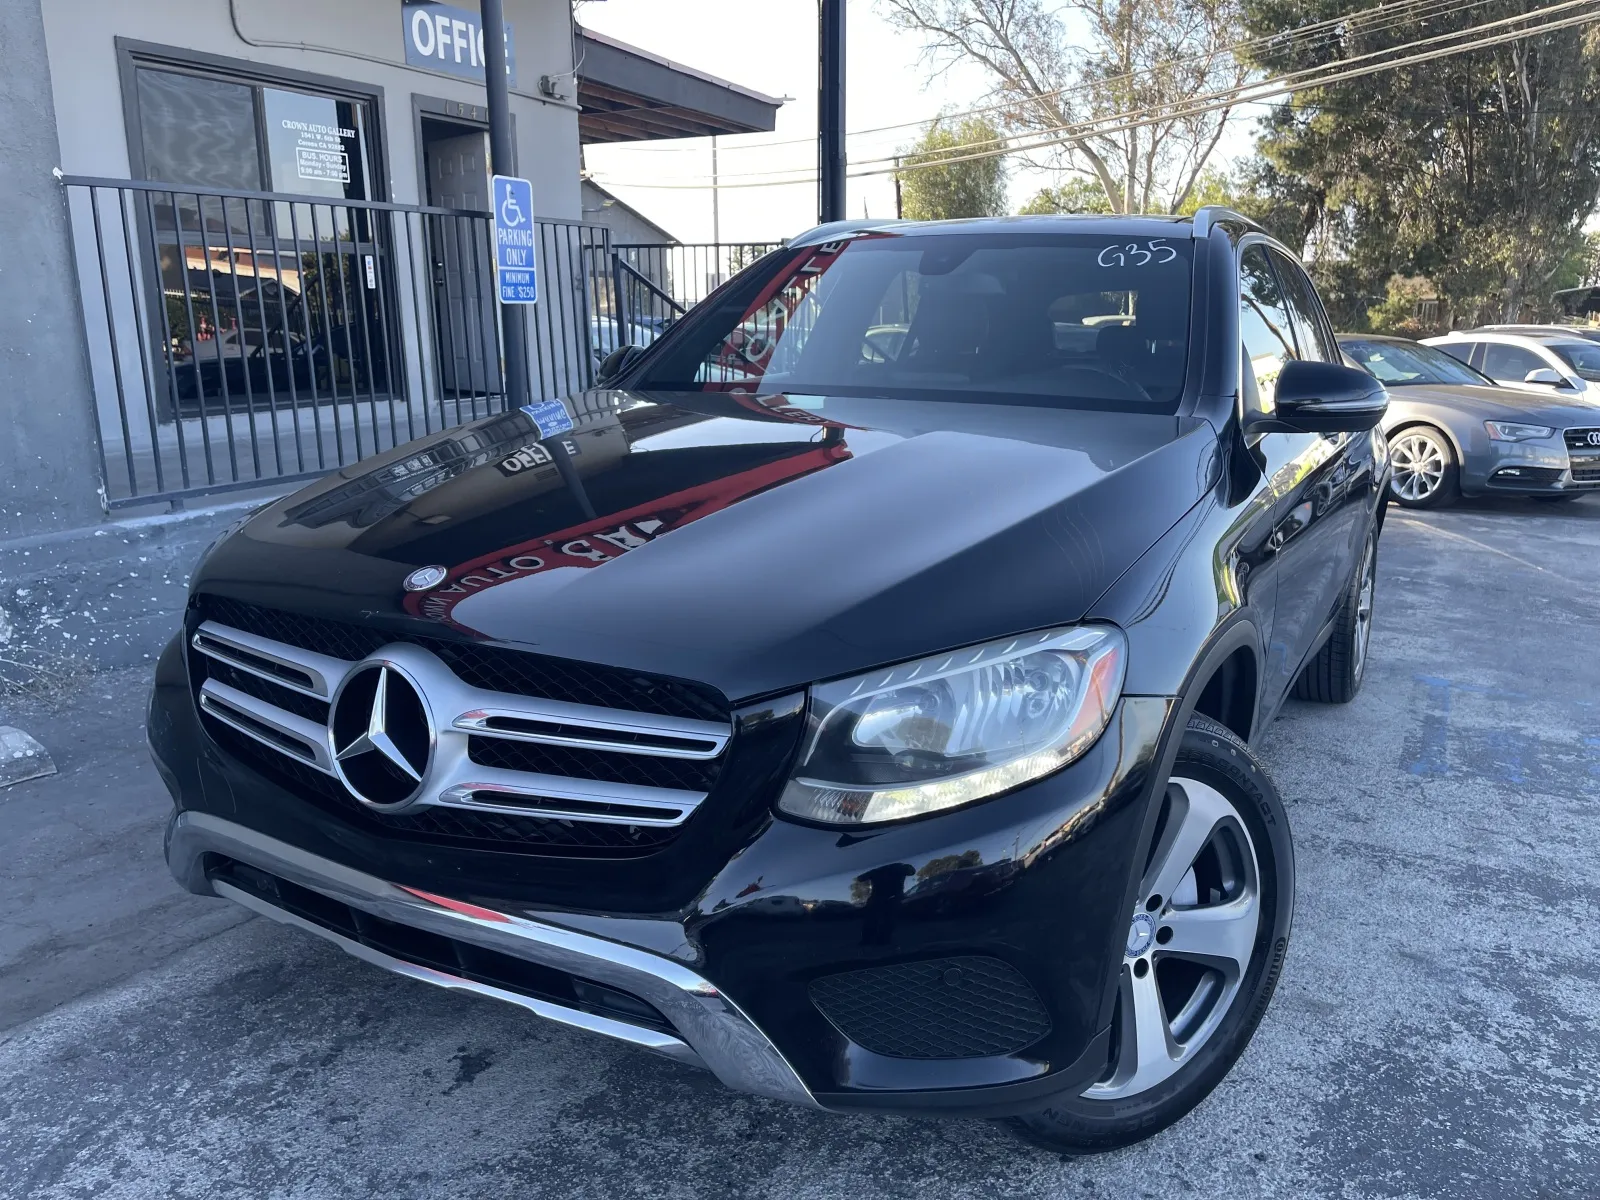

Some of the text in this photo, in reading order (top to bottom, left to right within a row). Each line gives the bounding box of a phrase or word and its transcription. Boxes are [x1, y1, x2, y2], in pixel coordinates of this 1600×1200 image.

[282, 120, 356, 138] CROWN AUTO GALLERY
[298, 139, 318, 148] Corona
[301, 151, 343, 163] BUS. HOURS
[300, 158, 321, 169] Monday
[326, 161, 346, 172] Sunday
[499, 227, 532, 247] PARKING
[506, 248, 527, 266] ONLY
[505, 271, 530, 284] MINIMUM
[502, 286, 535, 299] FINE $250
